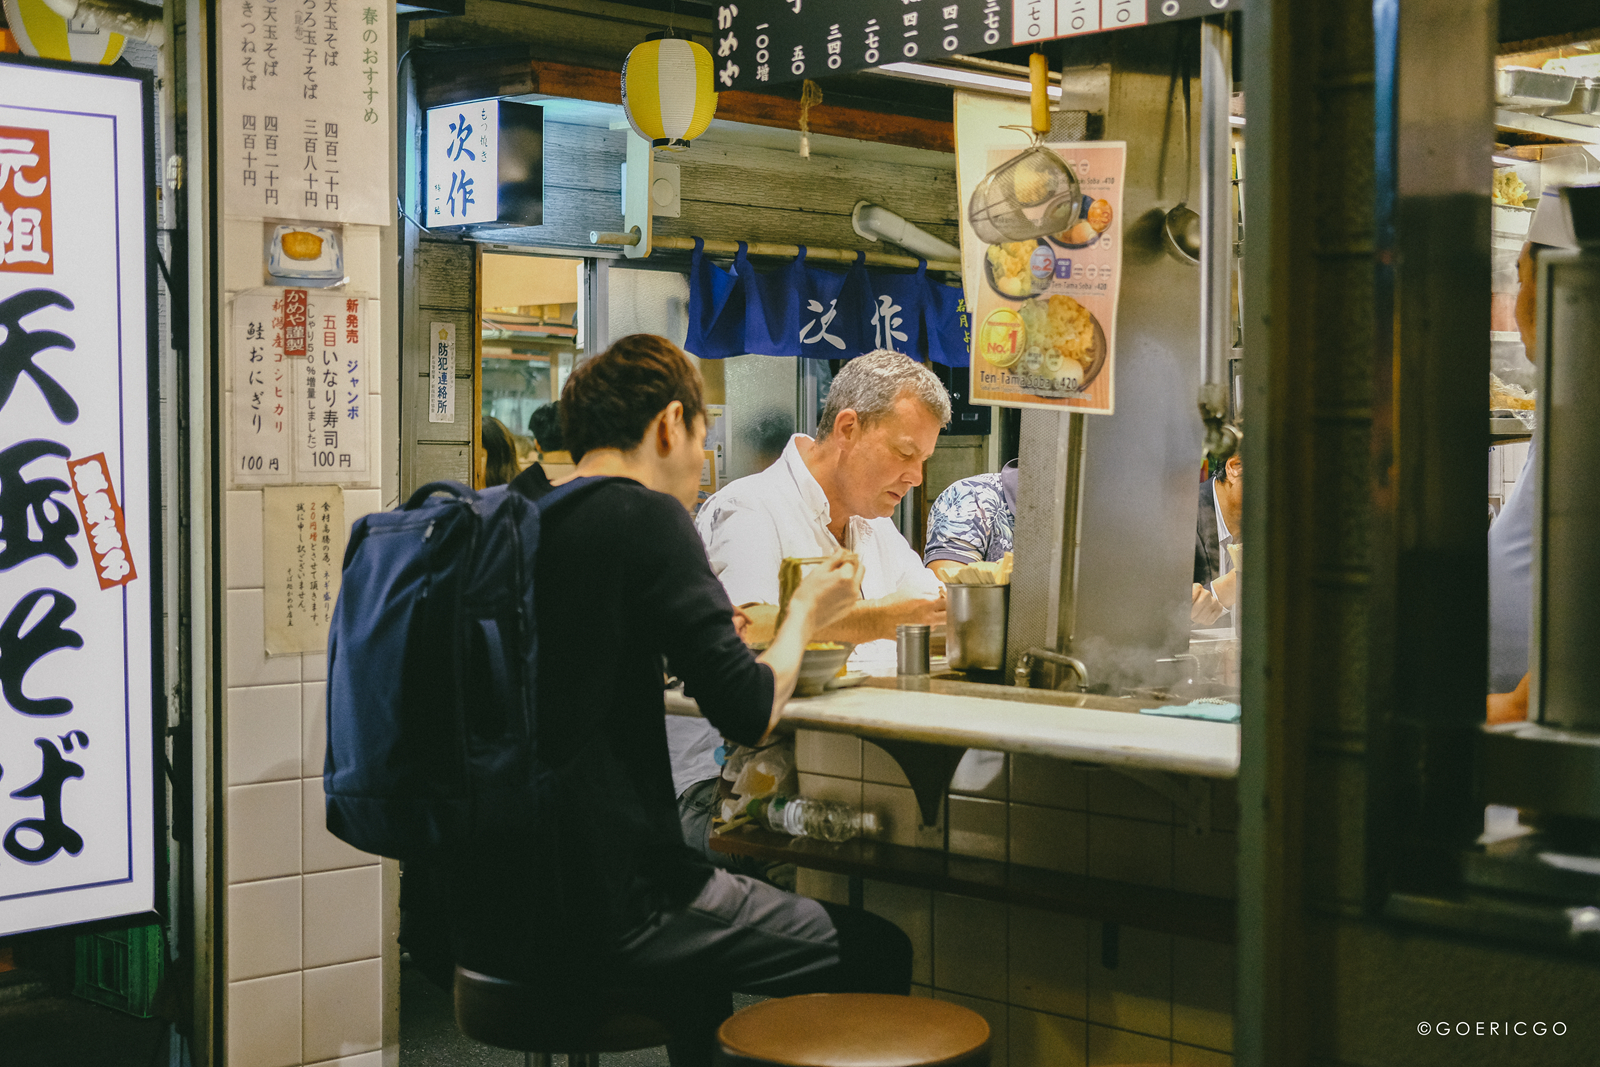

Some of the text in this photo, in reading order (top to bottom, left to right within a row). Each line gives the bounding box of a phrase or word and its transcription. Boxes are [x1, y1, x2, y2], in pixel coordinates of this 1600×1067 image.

[362, 7, 378, 124] 春のおすすめ
[718, 4, 740, 87] かめや
[241, 1, 257, 187] きつねそば 四百十円
[263, 0, 279, 205] 天玉そば 四百二十円
[303, 119, 318, 207] 三百八十円
[325, 123, 339, 210] 四百二十円
[446, 113, 476, 217] 次作
[272, 298, 284, 433] 新潟産コシヒカリ
[346, 298, 359, 420] 新発売 ジャンボ
[799, 295, 908, 350] 次作
[987, 330, 1018, 353] No.1
[246, 322, 265, 434] 鮭おにぎり
[323, 315, 338, 449] 五目いなり寿司
[437, 342, 449, 414] 防犯連絡所
[980, 371, 1026, 387] Ten-Tama
[241, 456, 279, 471] 100 円
[312, 451, 351, 468] 100 円
